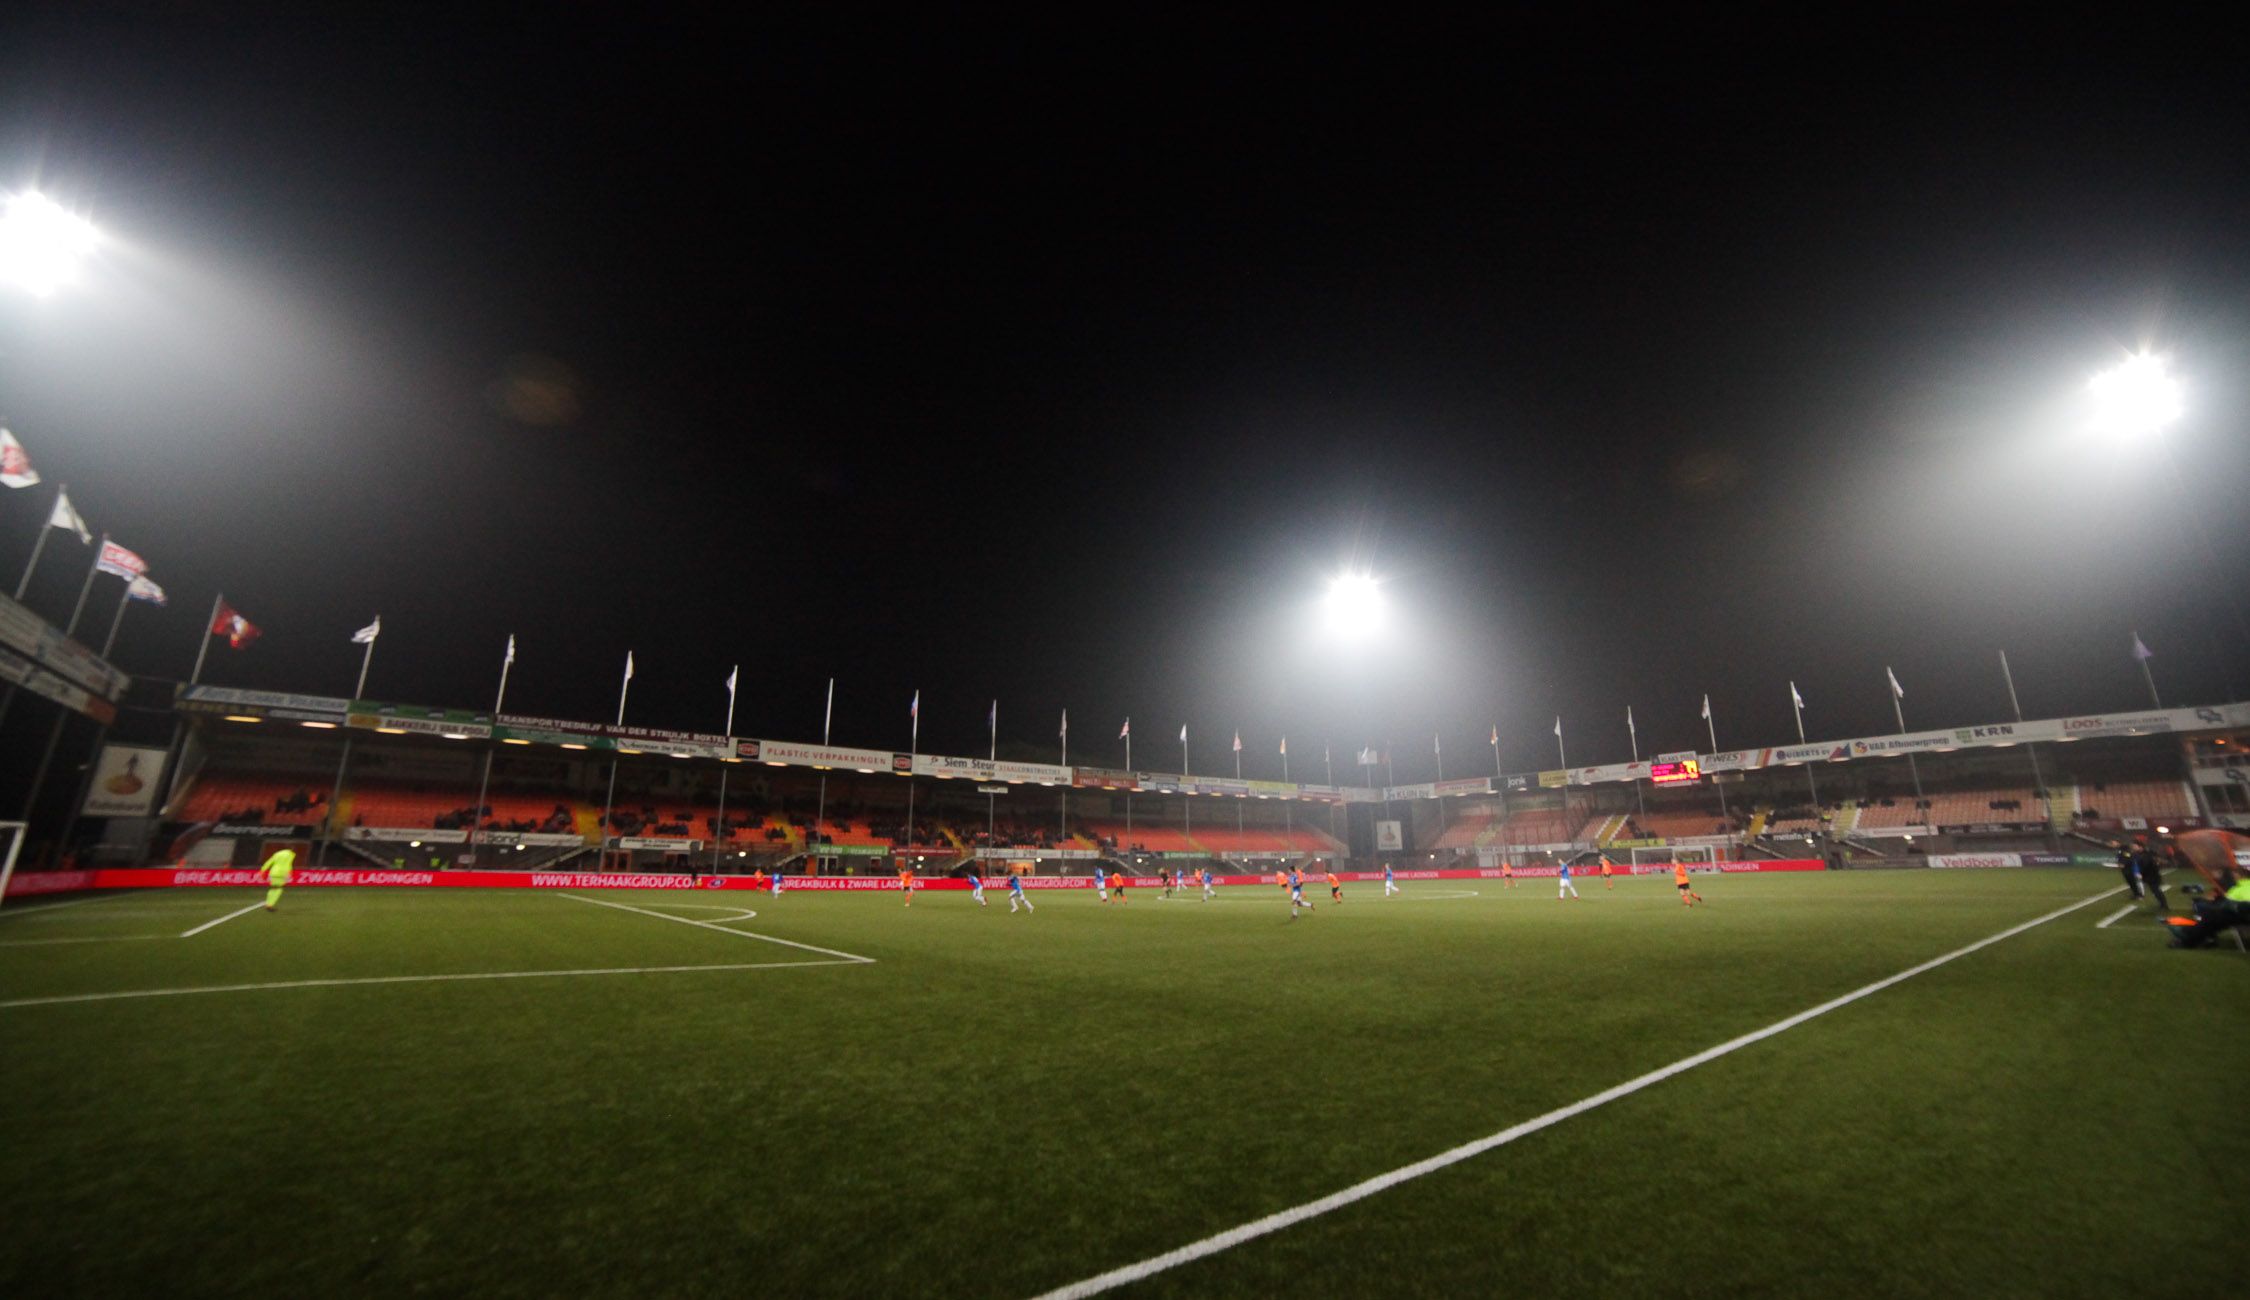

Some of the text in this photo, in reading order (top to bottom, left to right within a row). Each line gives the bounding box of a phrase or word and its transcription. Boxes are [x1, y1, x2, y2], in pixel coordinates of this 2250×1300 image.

[496, 715, 602, 732] TRANSPORTBEDRIJF
[606, 725, 626, 734] VAN
[628, 727, 648, 735] DER
[693, 733, 729, 743] BOXTEL
[2064, 718, 2102, 730] LOOS
[1974, 726, 2014, 737] KRN
[767, 748, 808, 759] PLASTIC
[812, 752, 886, 765] VERPAKKINGEN
[945, 757, 968, 768] Siem
[971, 758, 996, 770] Steur
[1941, 856, 2005, 867] Veldboer
[175, 871, 433, 884] BREAKBUL ZWARE LADINGEN
[848, 880, 879, 889] ZWARE
